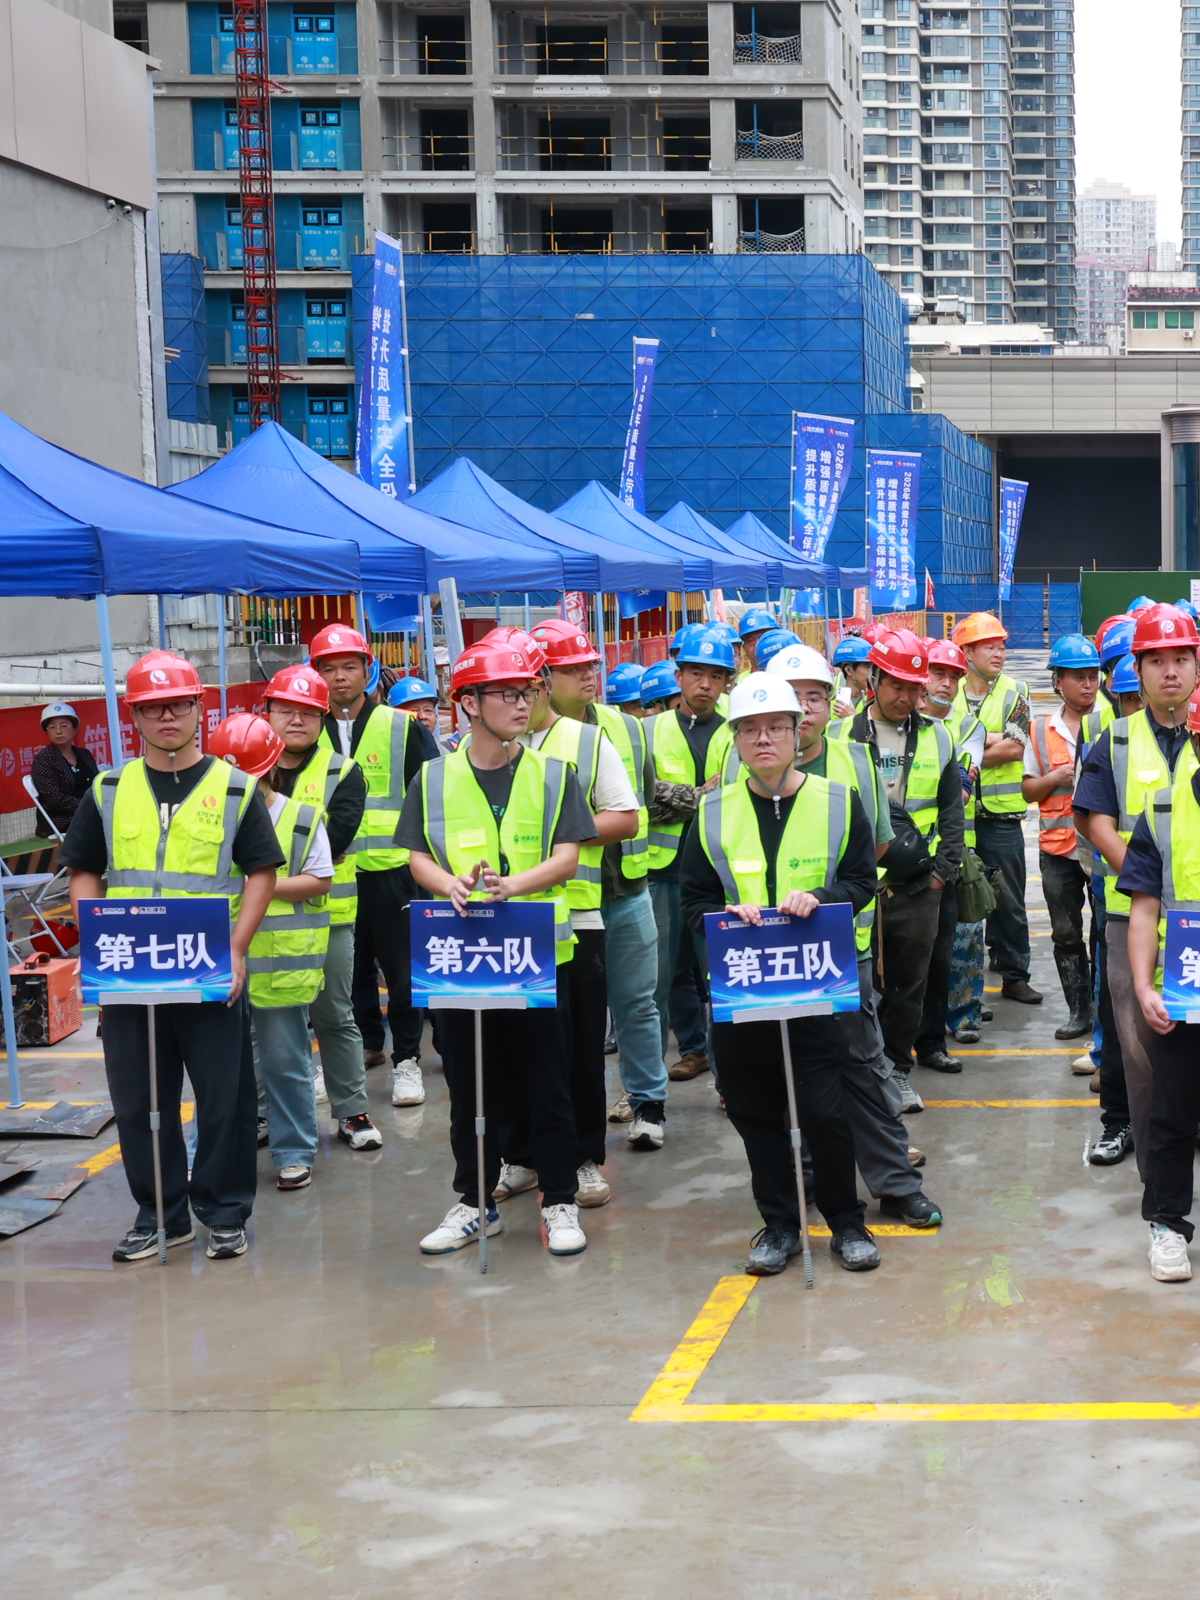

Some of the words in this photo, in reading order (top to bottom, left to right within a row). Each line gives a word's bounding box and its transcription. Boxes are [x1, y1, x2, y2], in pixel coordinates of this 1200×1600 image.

[875, 477, 887, 591] 提升质量安全保障水平
[887, 478, 899, 591] 增强质量技术基础能力
[95, 932, 217, 972] 第七队
[425, 935, 542, 975] 第六队
[723, 940, 843, 988] 第五队
